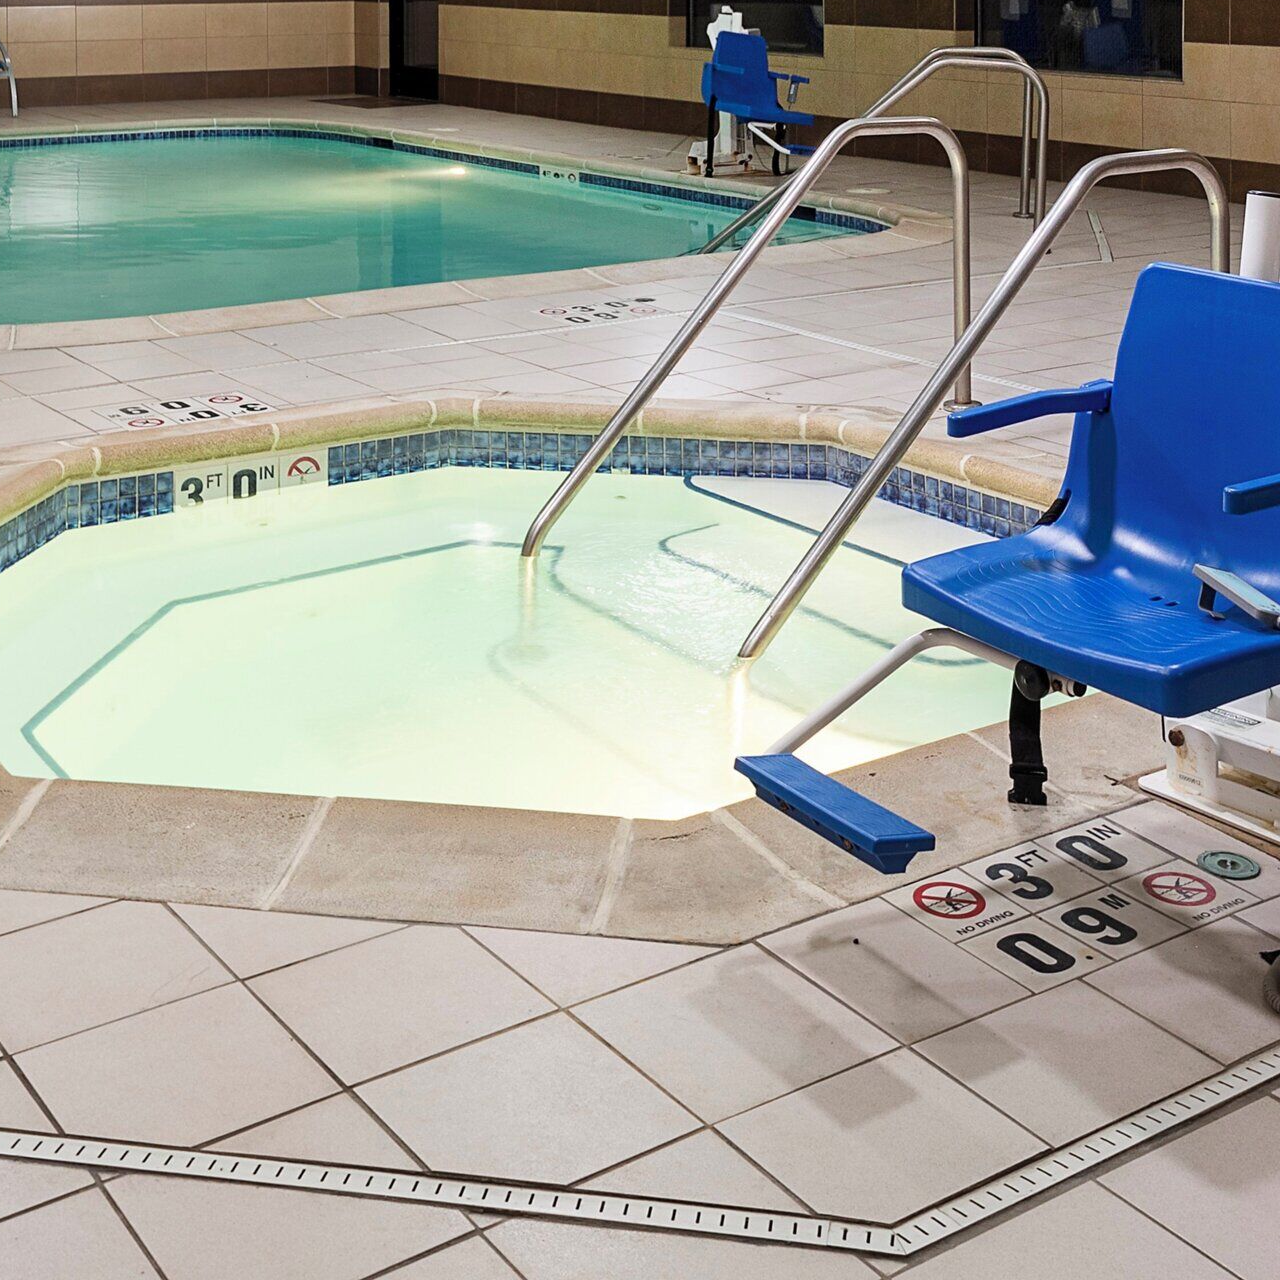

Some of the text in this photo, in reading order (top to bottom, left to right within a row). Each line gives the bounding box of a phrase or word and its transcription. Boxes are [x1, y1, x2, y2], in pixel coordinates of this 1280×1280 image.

[1192, 898, 1246, 922] NO DIVING
[956, 910, 1015, 936] NO DIVING
